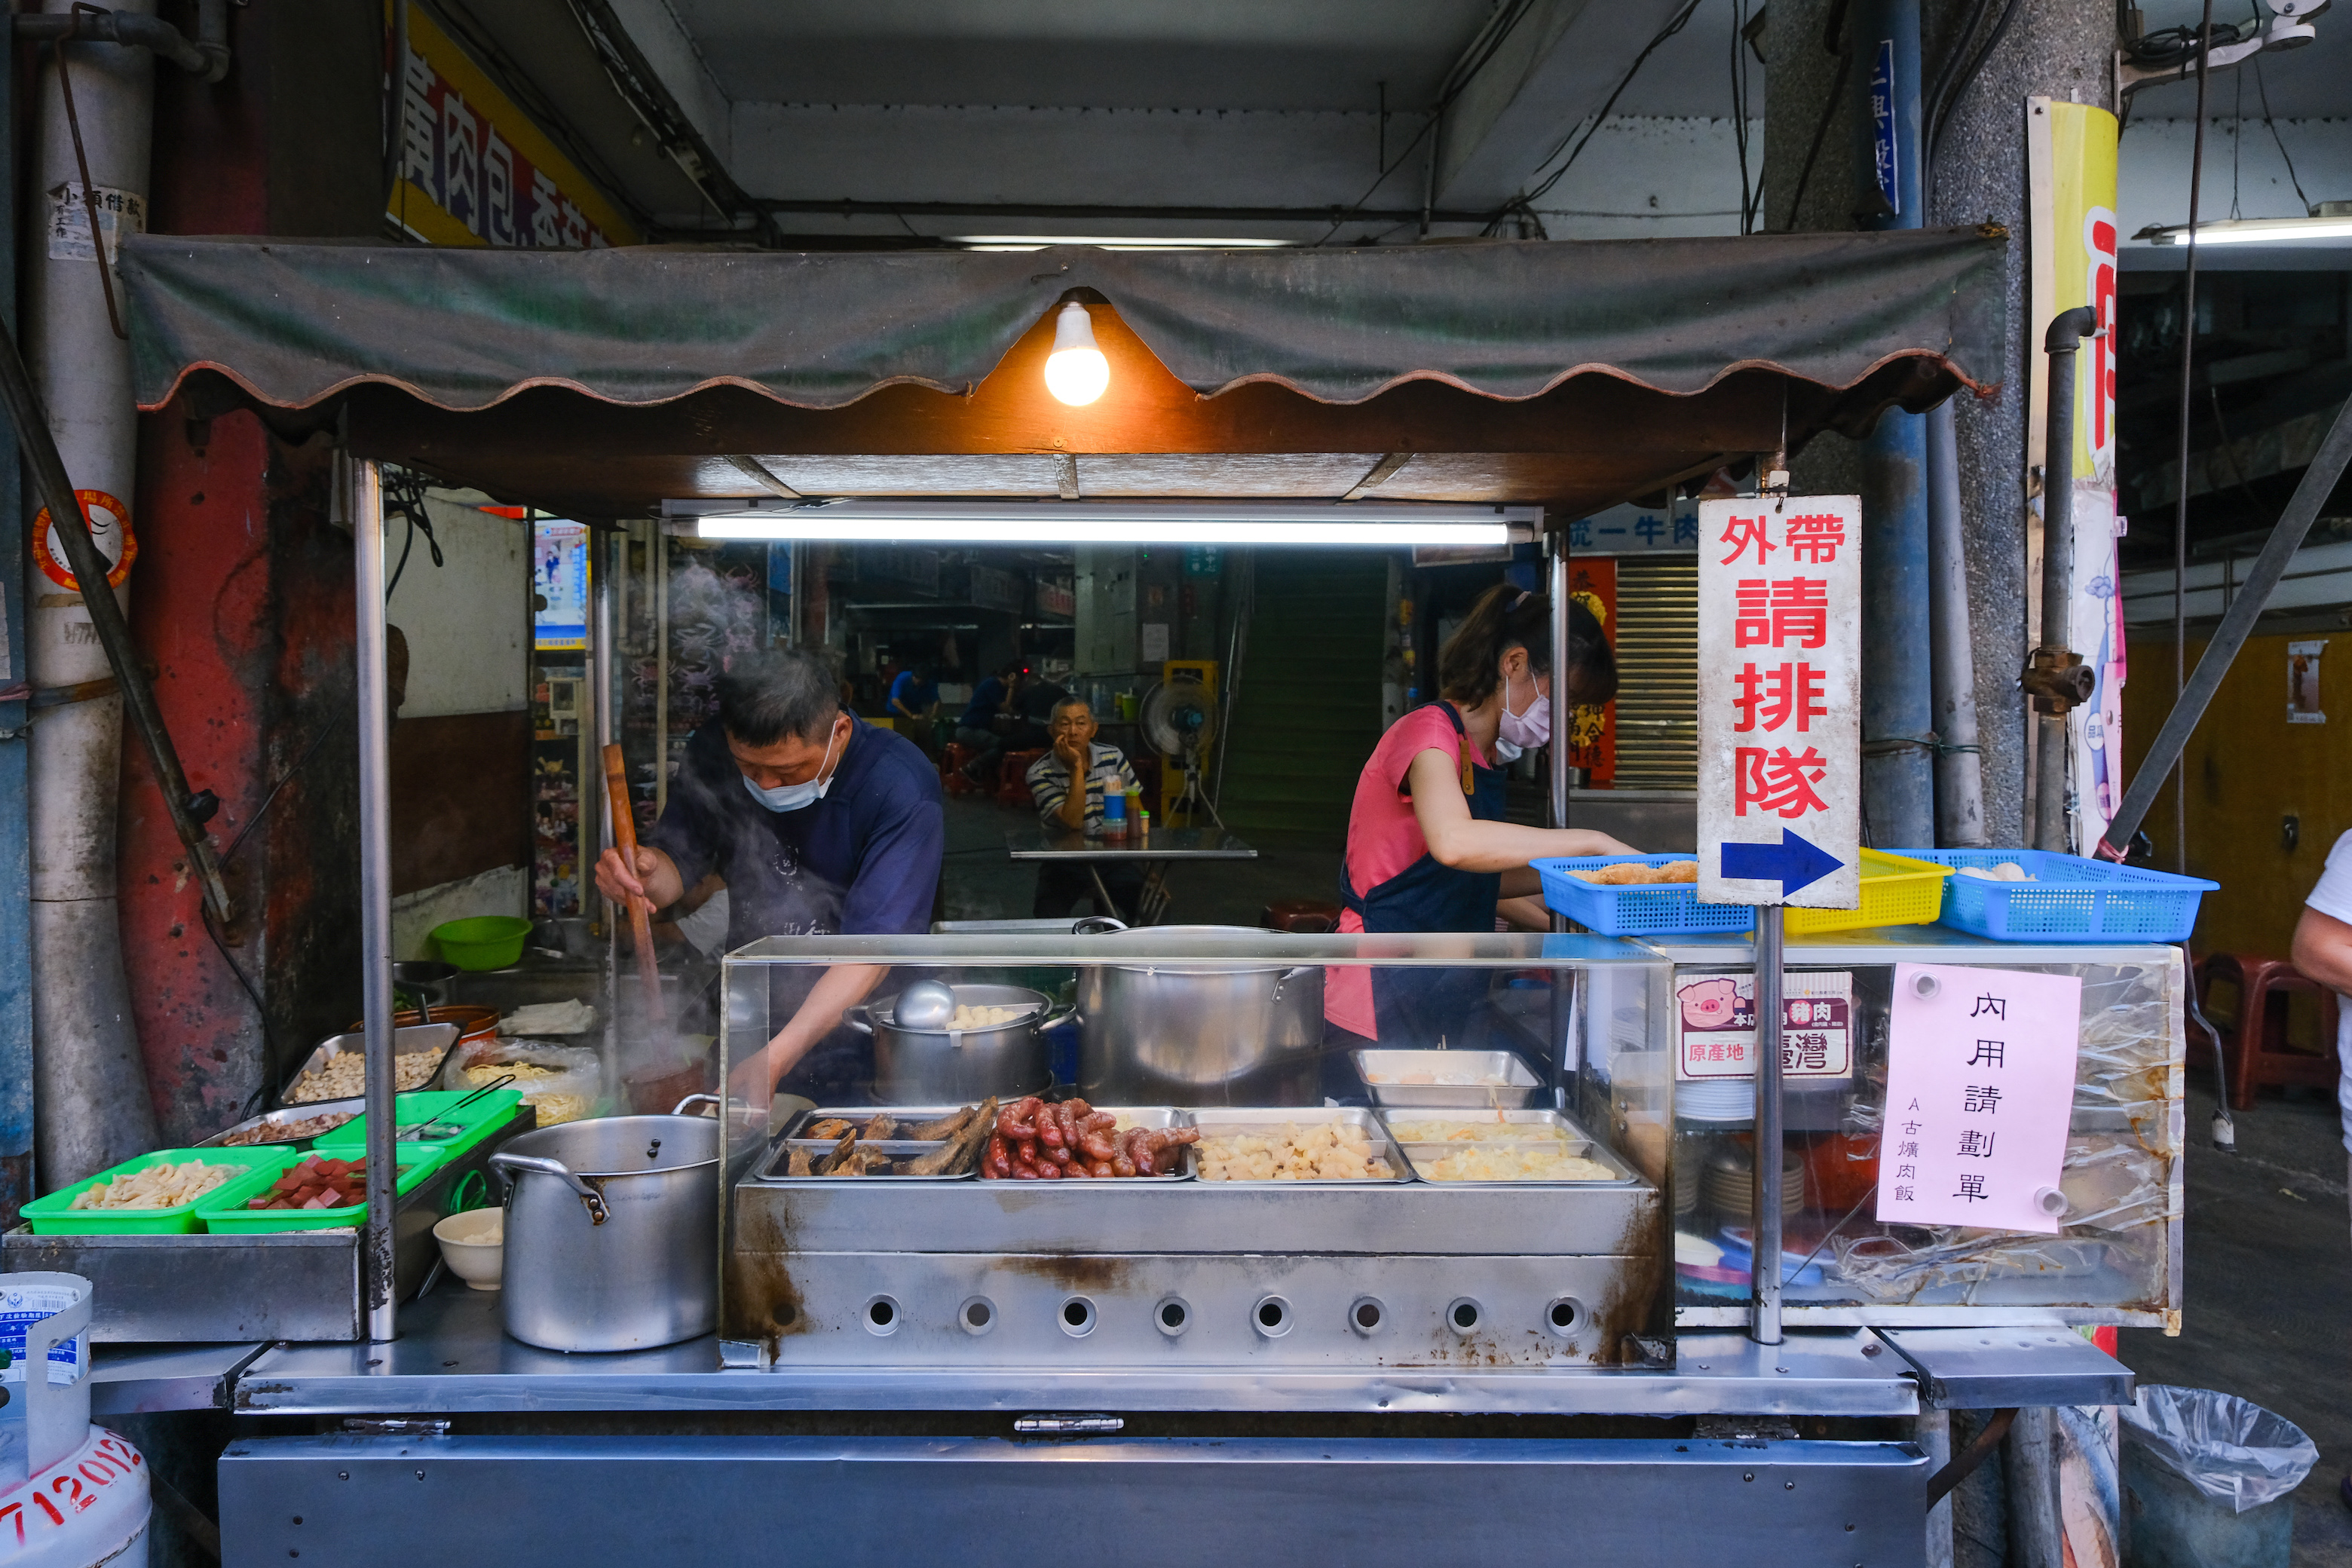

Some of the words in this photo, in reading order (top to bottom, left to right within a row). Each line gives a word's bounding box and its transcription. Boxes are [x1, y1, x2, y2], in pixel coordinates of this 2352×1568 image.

[1720, 514, 1845, 565] 外帶
[1734, 576, 1830, 819] 請排隊
[1689, 1043, 1744, 1062] 原產地
[1952, 991, 2006, 1203] 內用請劃單
